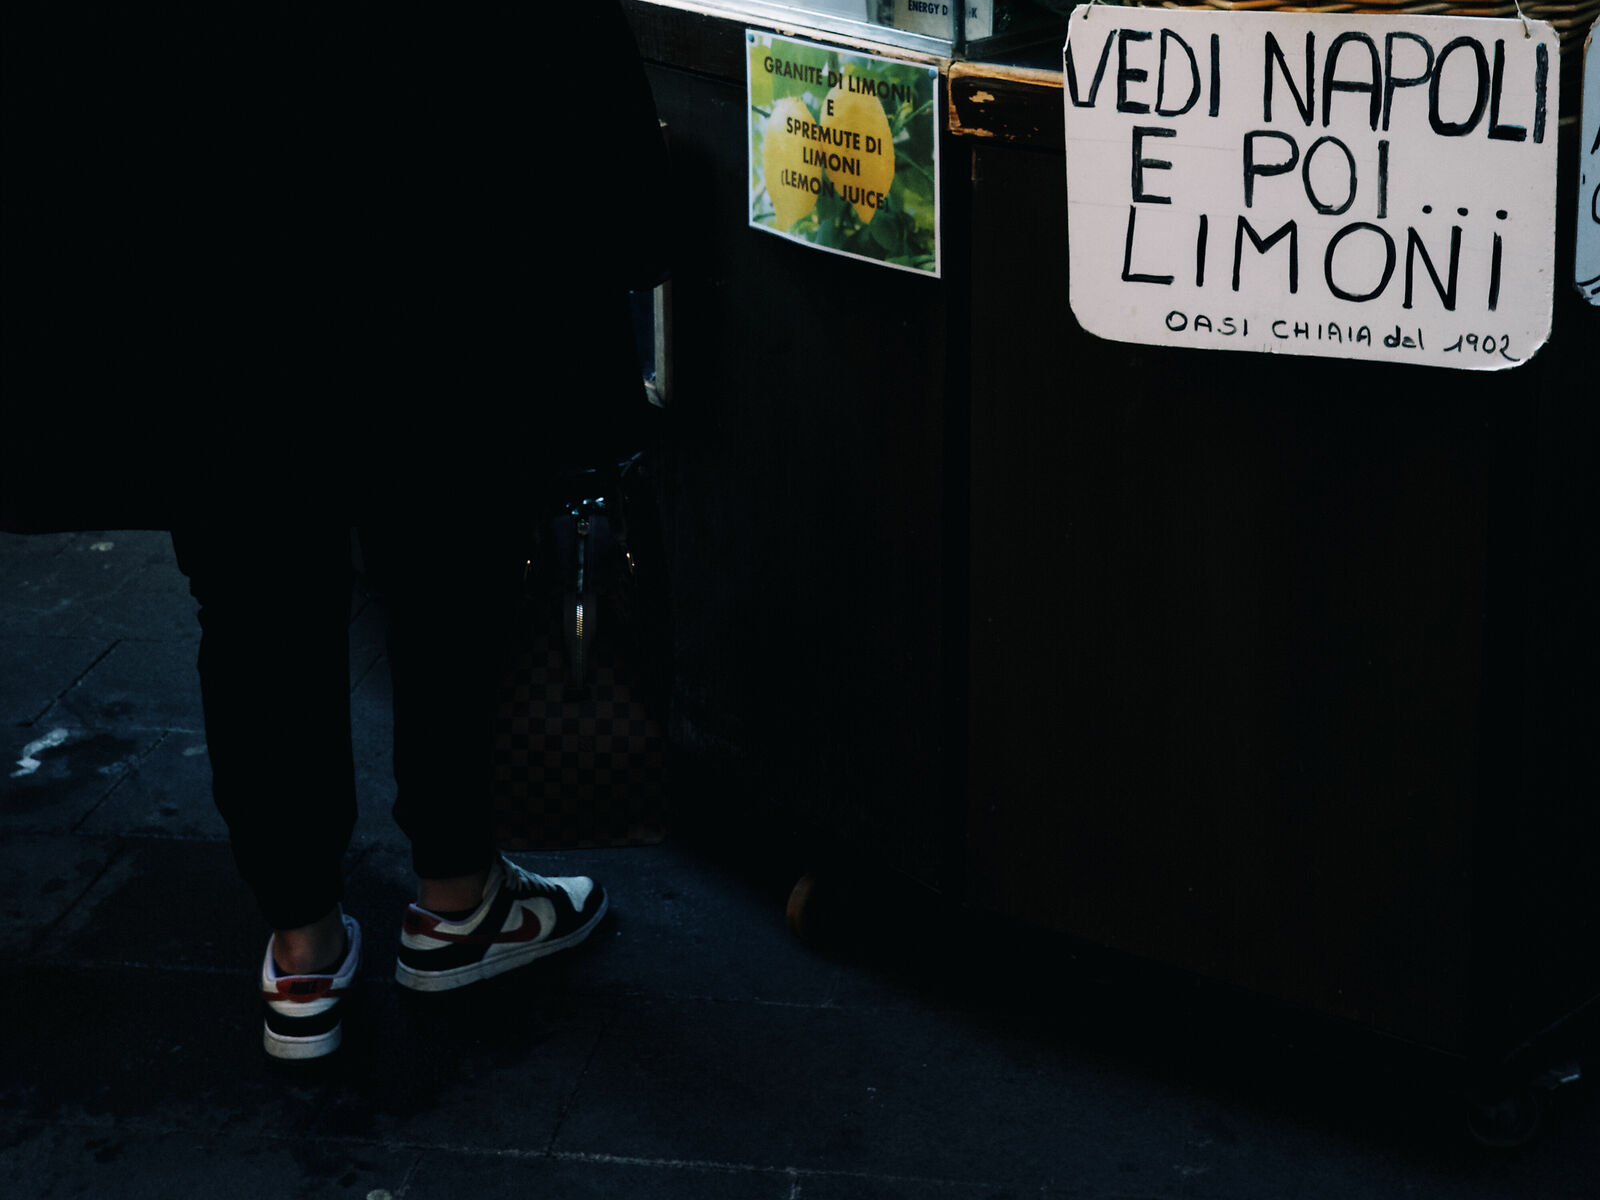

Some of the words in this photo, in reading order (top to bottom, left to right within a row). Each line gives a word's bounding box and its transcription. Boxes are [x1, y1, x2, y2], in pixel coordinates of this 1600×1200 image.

[908, 0, 940, 14] ENERGY
[764, 56, 822, 86] GRANITE
[827, 70, 843, 90] DI
[848, 75, 911, 103] LIMONI
[1066, 28, 1221, 118] VEDI
[1264, 31, 1549, 144] NAPOLI
[827, 99, 834, 116] E
[786, 117, 861, 150] SPREMUTE
[866, 136, 882, 155] DI
[802, 147, 860, 176] LIMONI
[1132, 126, 1177, 205] E
[781, 168, 834, 198] (LEMON
[1121, 205, 1503, 311] LIMONI
[1166, 311, 1249, 337] OASI
[1272, 319, 1373, 348] CHIAIA
[1444, 334, 1521, 362] 1902
